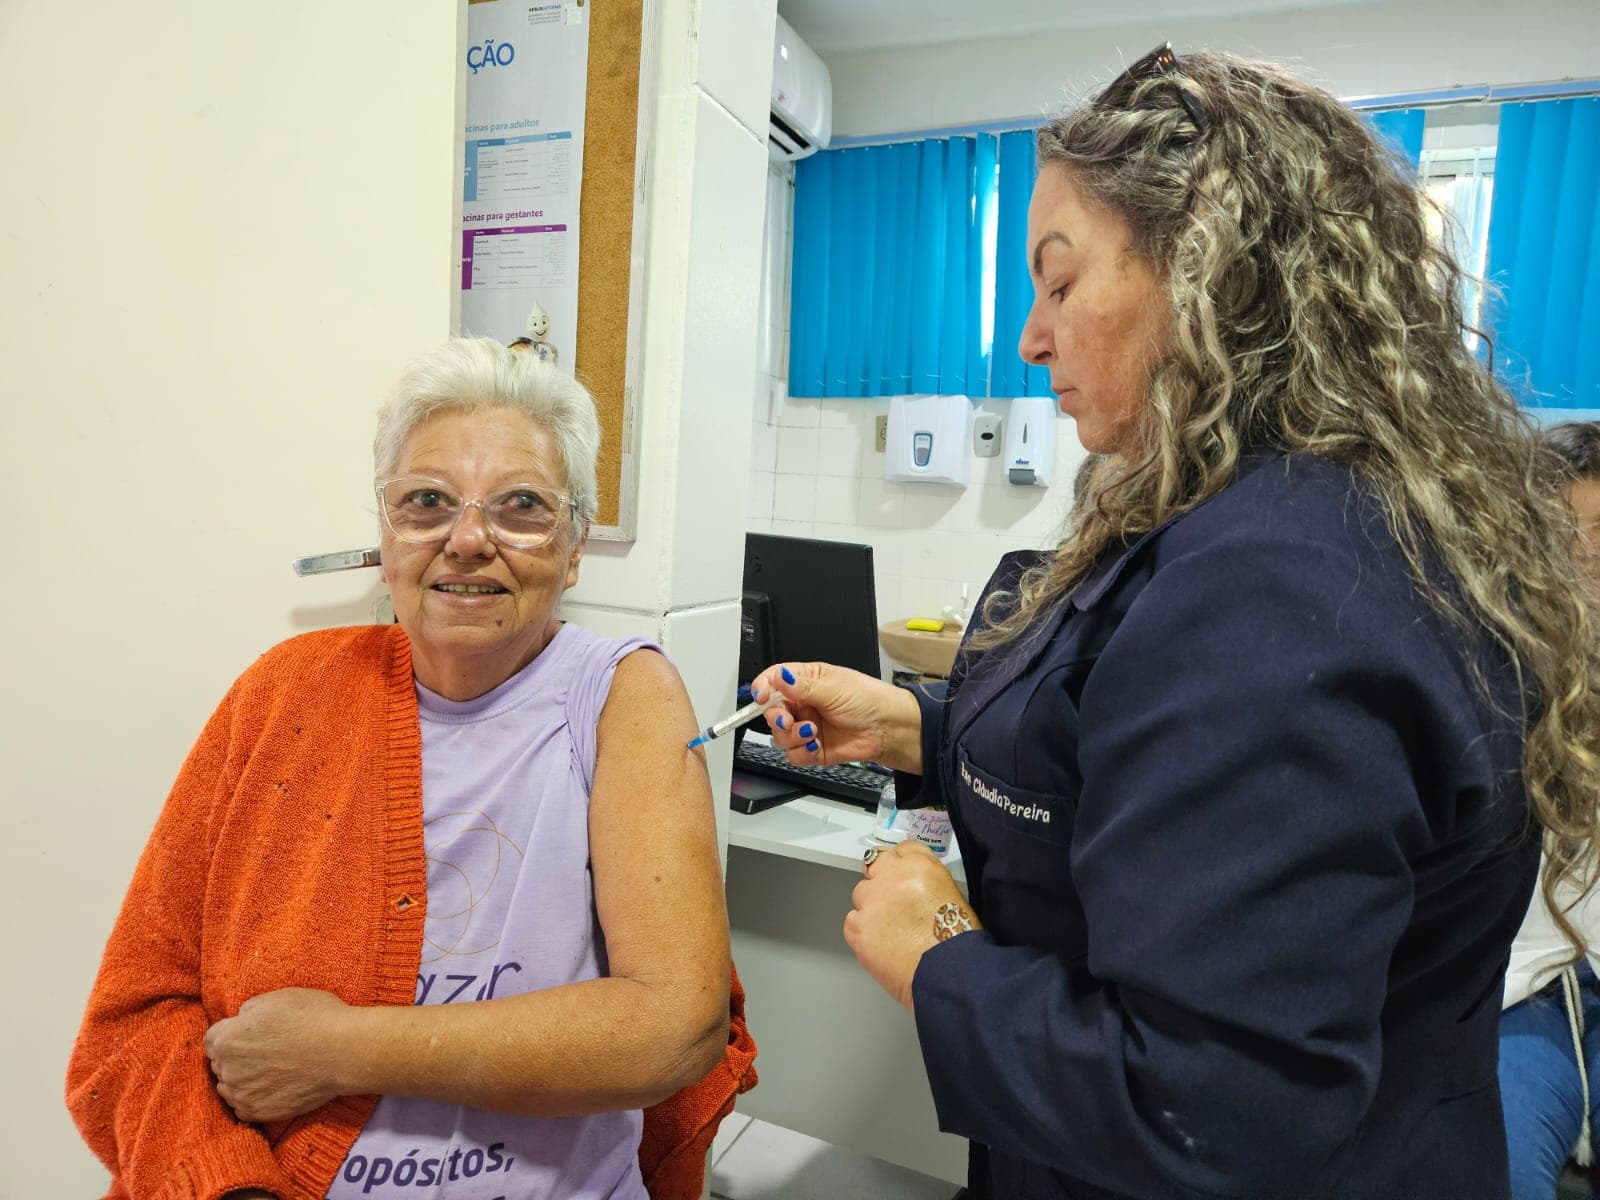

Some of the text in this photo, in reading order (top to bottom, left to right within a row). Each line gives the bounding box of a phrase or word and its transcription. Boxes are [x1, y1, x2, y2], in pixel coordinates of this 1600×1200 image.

[467, 40, 515, 75] ÇÃO
[490, 122, 508, 133] para
[509, 119, 539, 130] adultos
[486, 212, 504, 223] para
[505, 209, 544, 221] gestantes
[1003, 795, 1051, 823] Pereira
